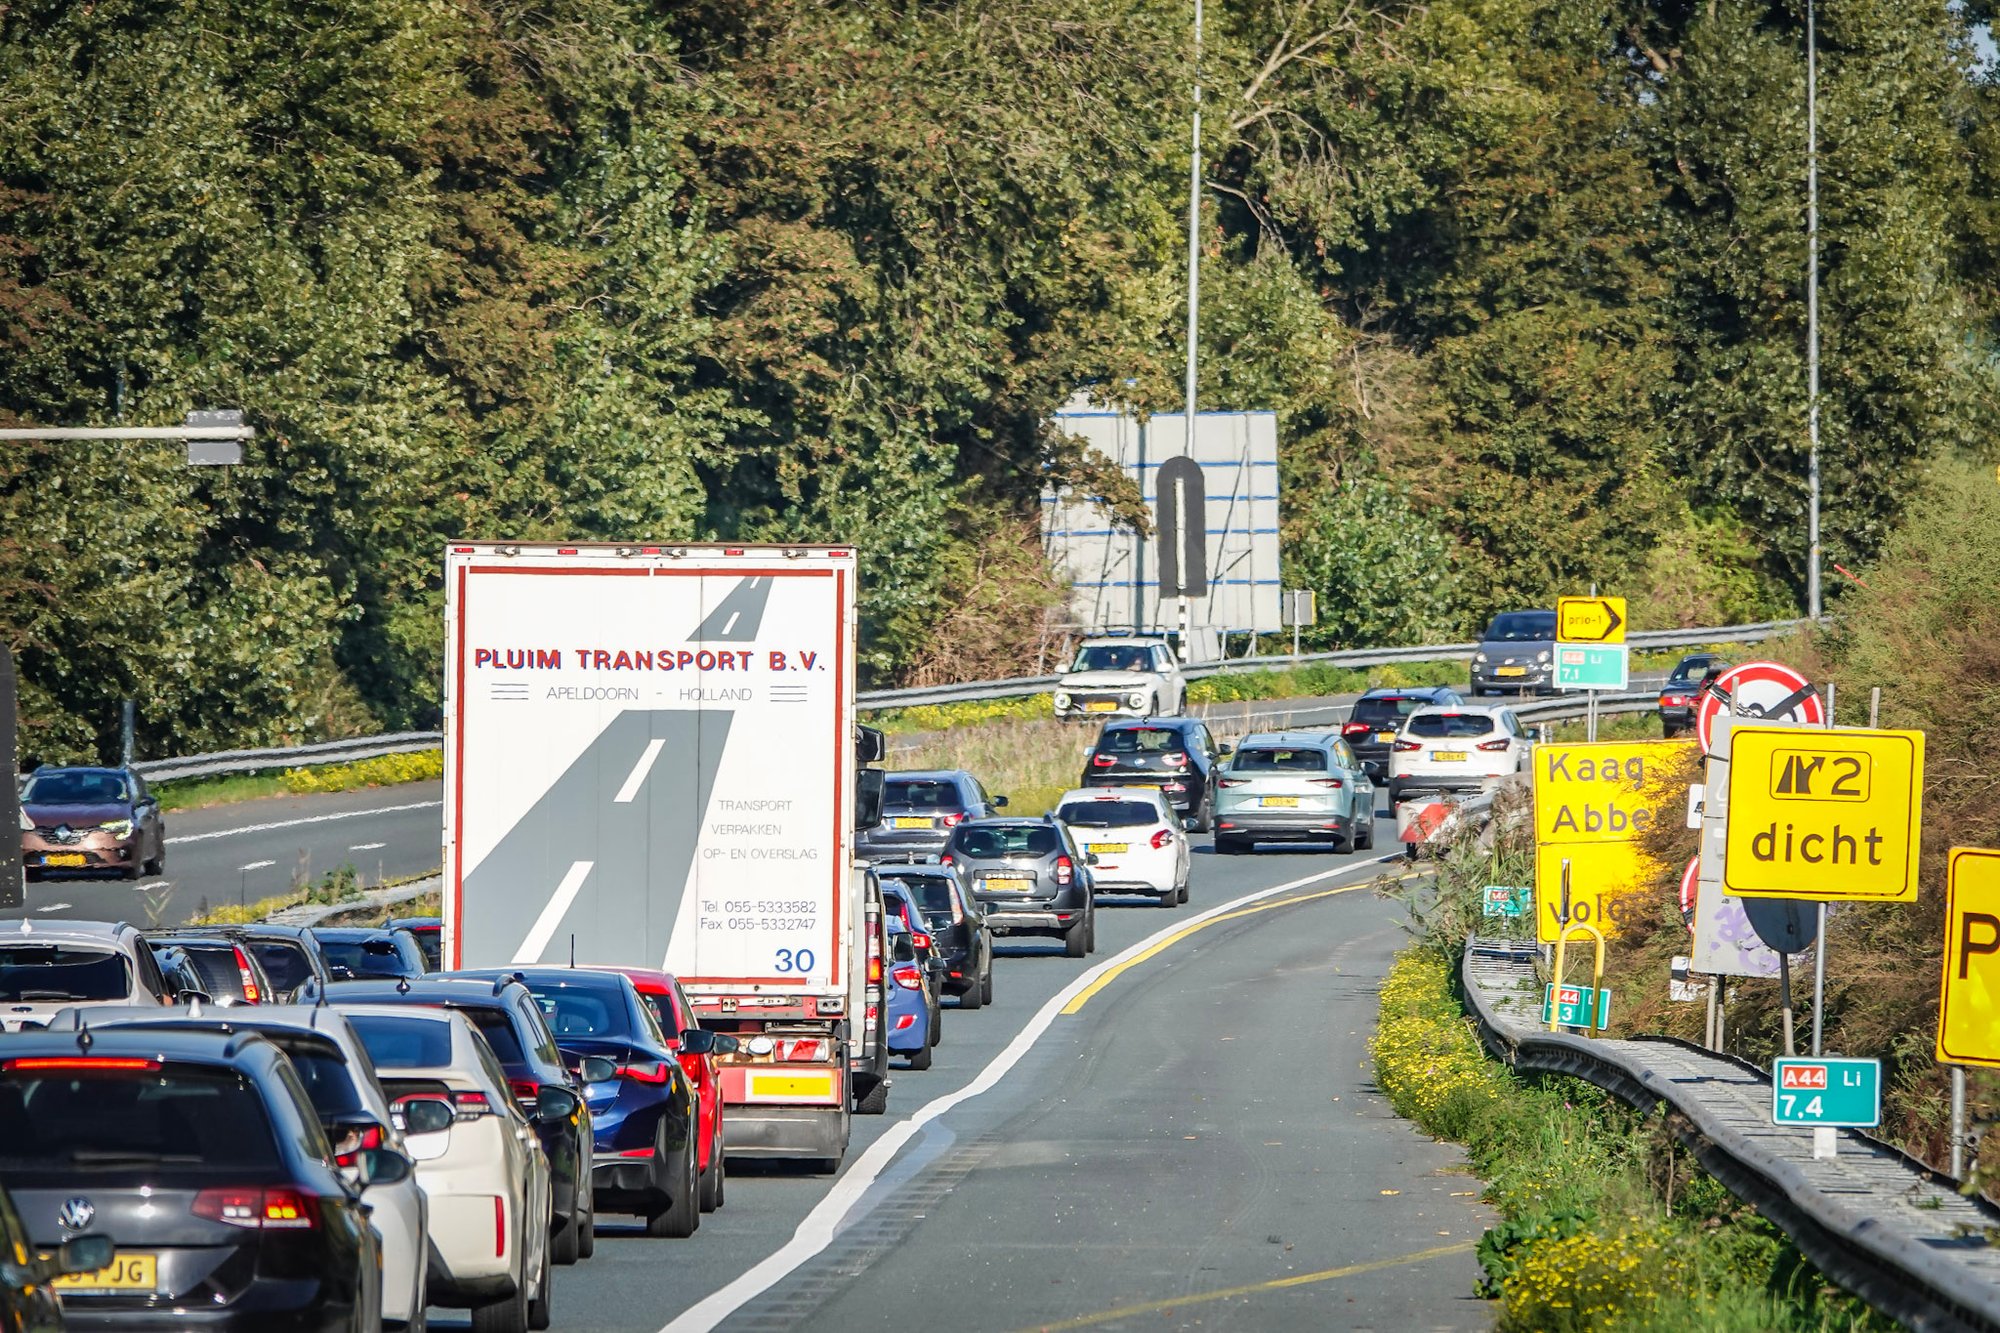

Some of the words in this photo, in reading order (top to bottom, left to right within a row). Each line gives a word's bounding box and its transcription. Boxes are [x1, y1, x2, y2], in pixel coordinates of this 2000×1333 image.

[475, 648, 561, 669] PLUIM
[575, 649, 754, 671] TRANSPORT
[769, 651, 825, 671] B.V.
[1562, 667, 1580, 681] 7.1
[546, 687, 639, 700] APELDOORN
[680, 688, 752, 701] HOLLAND
[1548, 753, 1643, 789] Kaag
[1831, 757, 1861, 796] 2
[718, 800, 792, 811] TRANSPORT
[711, 824, 781, 835] VERPAKKEN
[1751, 822, 1883, 866] dicht
[703, 848, 726, 860] OP-
[730, 849, 746, 860] EN
[750, 848, 818, 860] OVERSLAG
[725, 901, 817, 913] 055-5333582
[700, 917, 723, 929] Fax
[728, 918, 816, 930] 055-5332747
[775, 949, 815, 972] 30
[1784, 1070, 1825, 1086] A44
[1843, 1070, 1861, 1086] Li
[1780, 1095, 1823, 1119] 7.4
